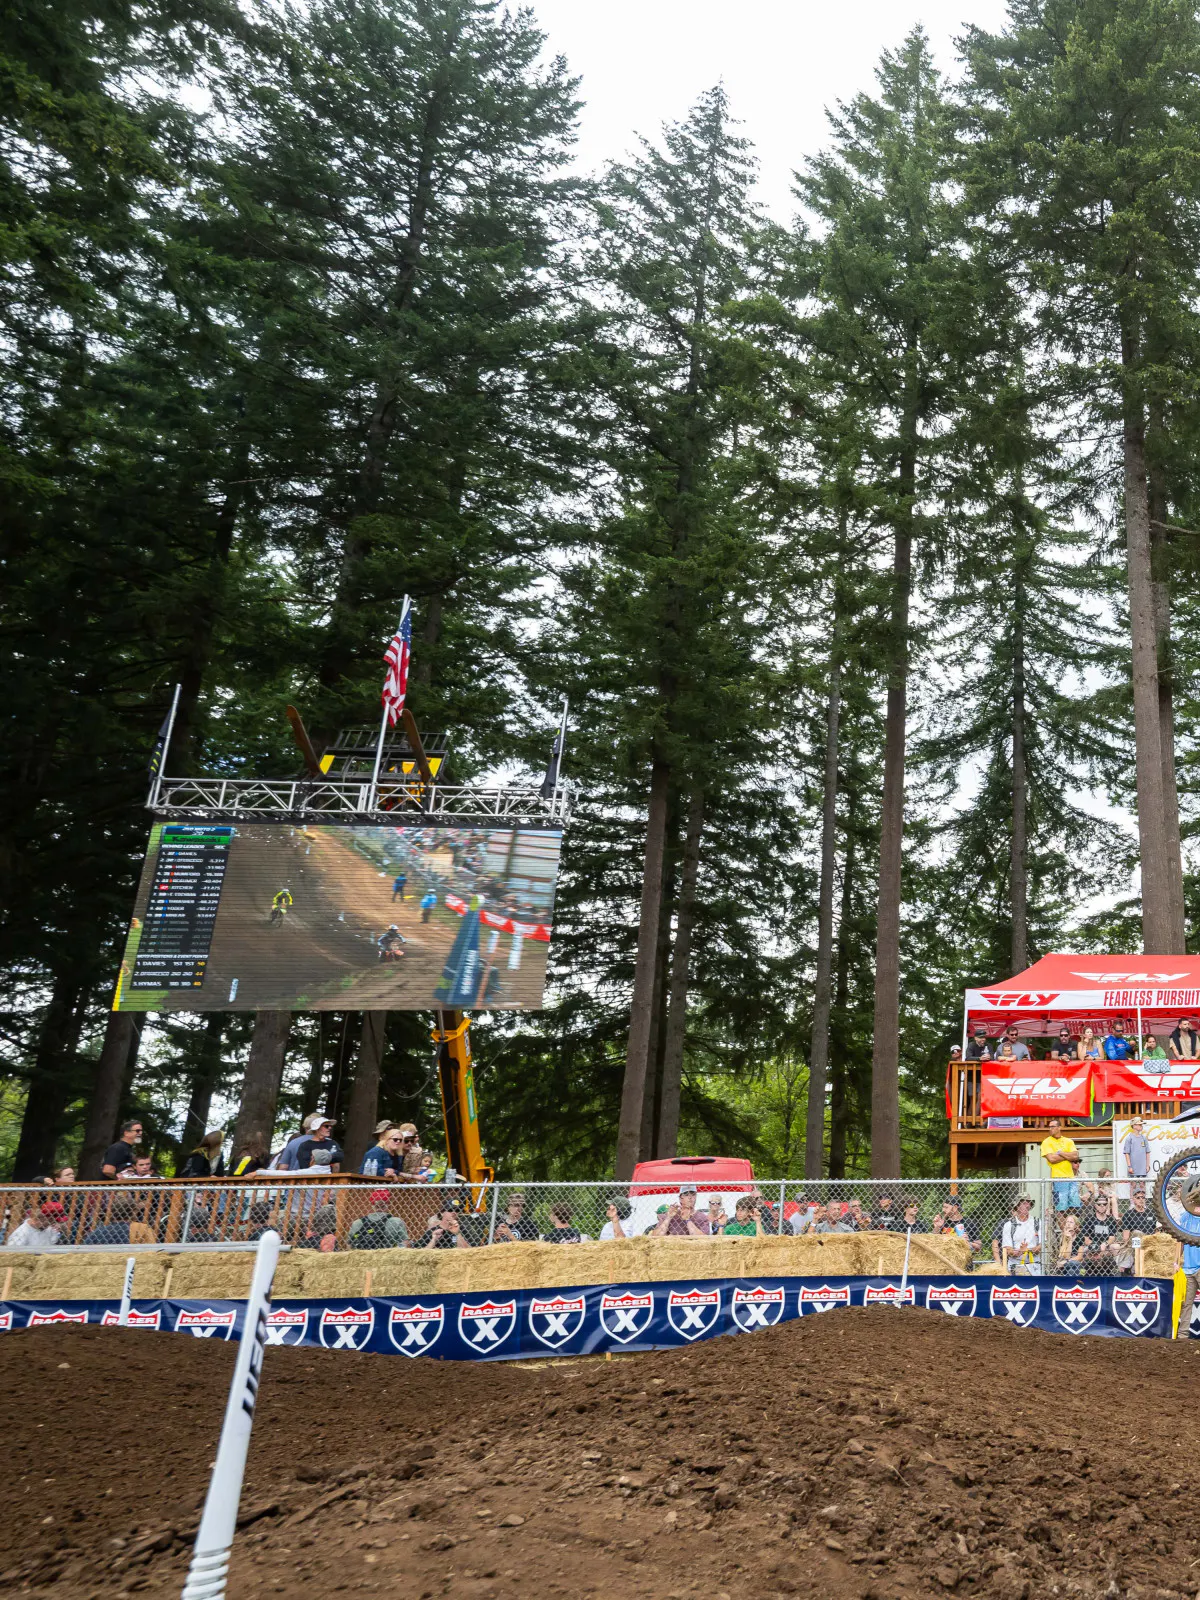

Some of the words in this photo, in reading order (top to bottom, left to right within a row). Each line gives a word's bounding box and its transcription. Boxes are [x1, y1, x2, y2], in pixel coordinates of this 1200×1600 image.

[980, 993, 1061, 1006] FLY
[1103, 990, 1153, 1007] FEARLESS
[1156, 989, 1200, 1006] PURSUIT
[986, 1077, 1088, 1094] FLY
[604, 1298, 649, 1307] RACER
[671, 1295, 716, 1304] RACER
[738, 1293, 783, 1301] RACER
[994, 1291, 1037, 1299] RACER
[1057, 1291, 1099, 1299] RACER
[1116, 1292, 1156, 1300] RACER
[463, 1306, 511, 1316] RACER
[534, 1302, 580, 1312] RACER
[743, 1303, 771, 1326] X
[1004, 1301, 1026, 1323] X
[1064, 1301, 1089, 1323] X
[1124, 1302, 1150, 1324] X
[181, 1316, 232, 1324] RACER
[265, 1315, 305, 1323] ACER
[325, 1314, 370, 1322] RACER
[393, 1311, 439, 1320] RACER
[611, 1308, 640, 1333] X
[679, 1305, 708, 1329] X
[471, 1317, 501, 1342] X
[541, 1312, 570, 1338] X
[264, 1326, 293, 1345] X
[331, 1325, 360, 1348] X
[400, 1321, 429, 1347] X
